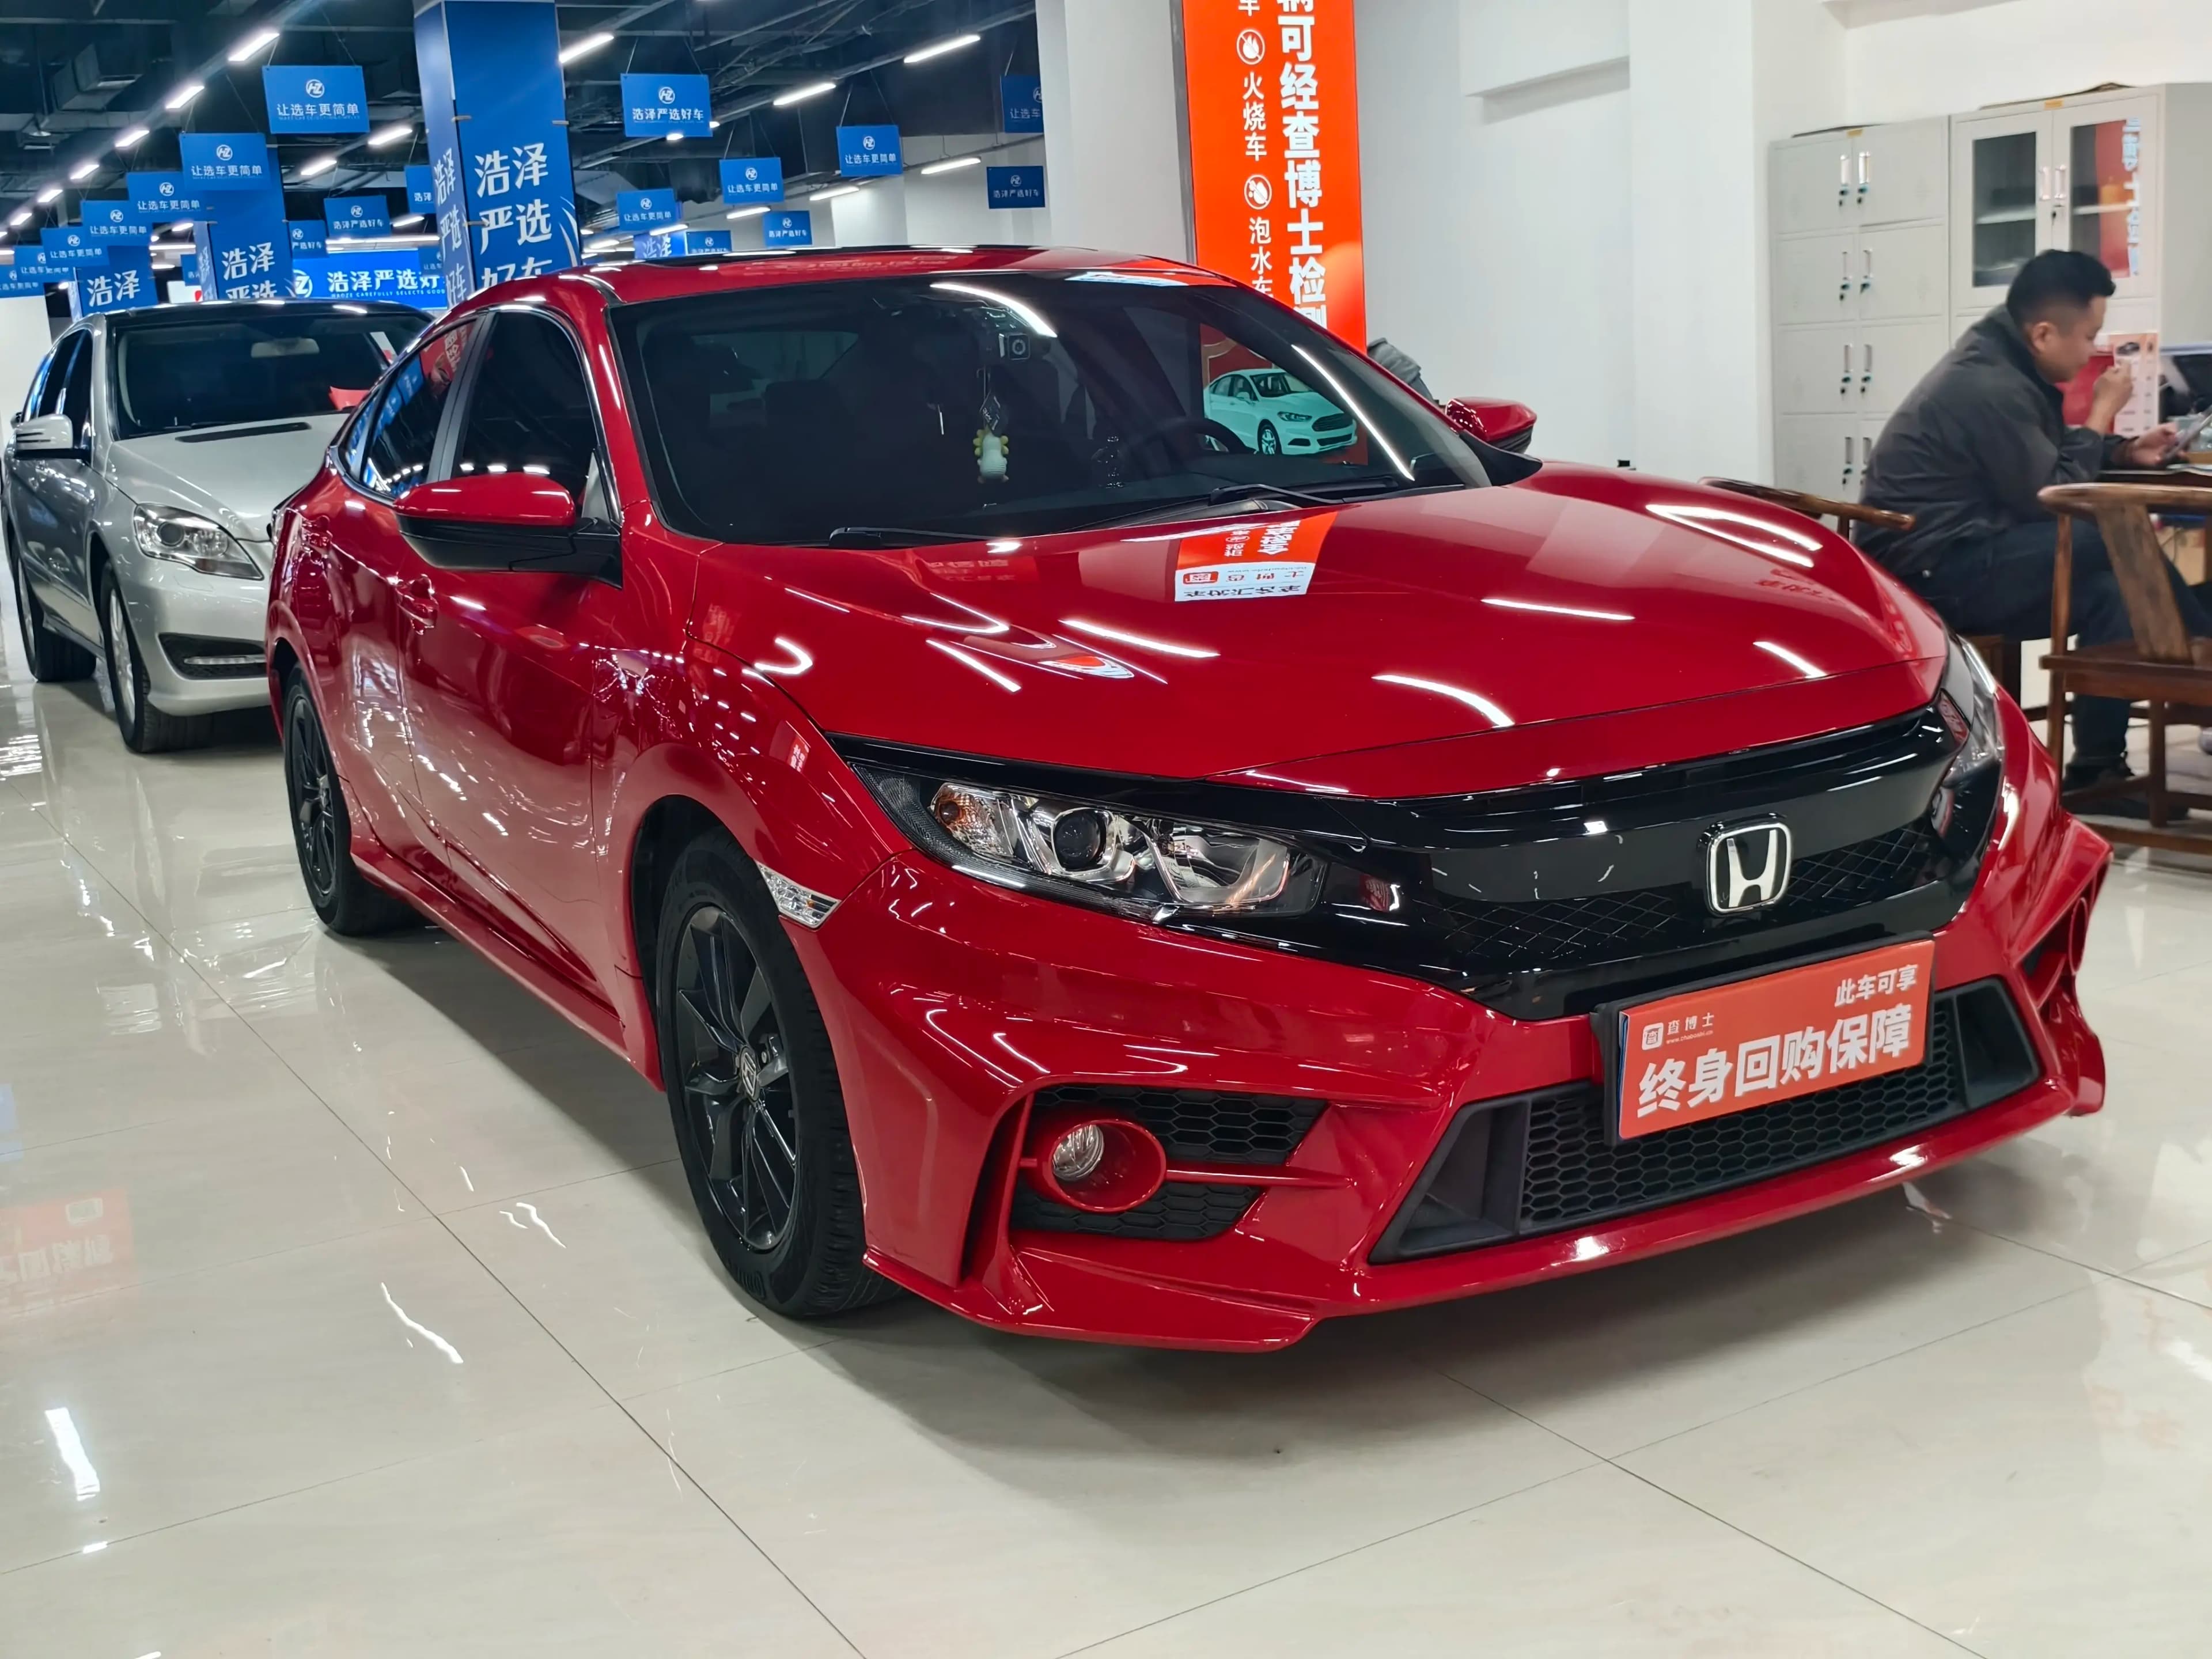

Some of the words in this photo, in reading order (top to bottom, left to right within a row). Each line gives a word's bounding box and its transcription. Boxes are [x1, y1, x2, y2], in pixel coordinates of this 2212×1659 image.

[276, 103, 359, 116] 让选车更简单
[632, 108, 704, 120] 浩泽严选好车
[1243, 71, 1267, 161] 火烧车
[191, 165, 262, 176] 让选车更简单
[474, 142, 548, 198] 浩泽
[1277, 0, 1327, 329] 可经查博士检
[138, 200, 200, 211] 让选车更简单
[479, 199, 552, 255] 严选
[221, 242, 275, 281] 浩泽
[87, 270, 141, 307] 浩泽
[1834, 964, 1918, 1007] 此车可享
[1666, 1012, 1715, 1035] 查博士
[1637, 1002, 1912, 1119] 终身回购保障
